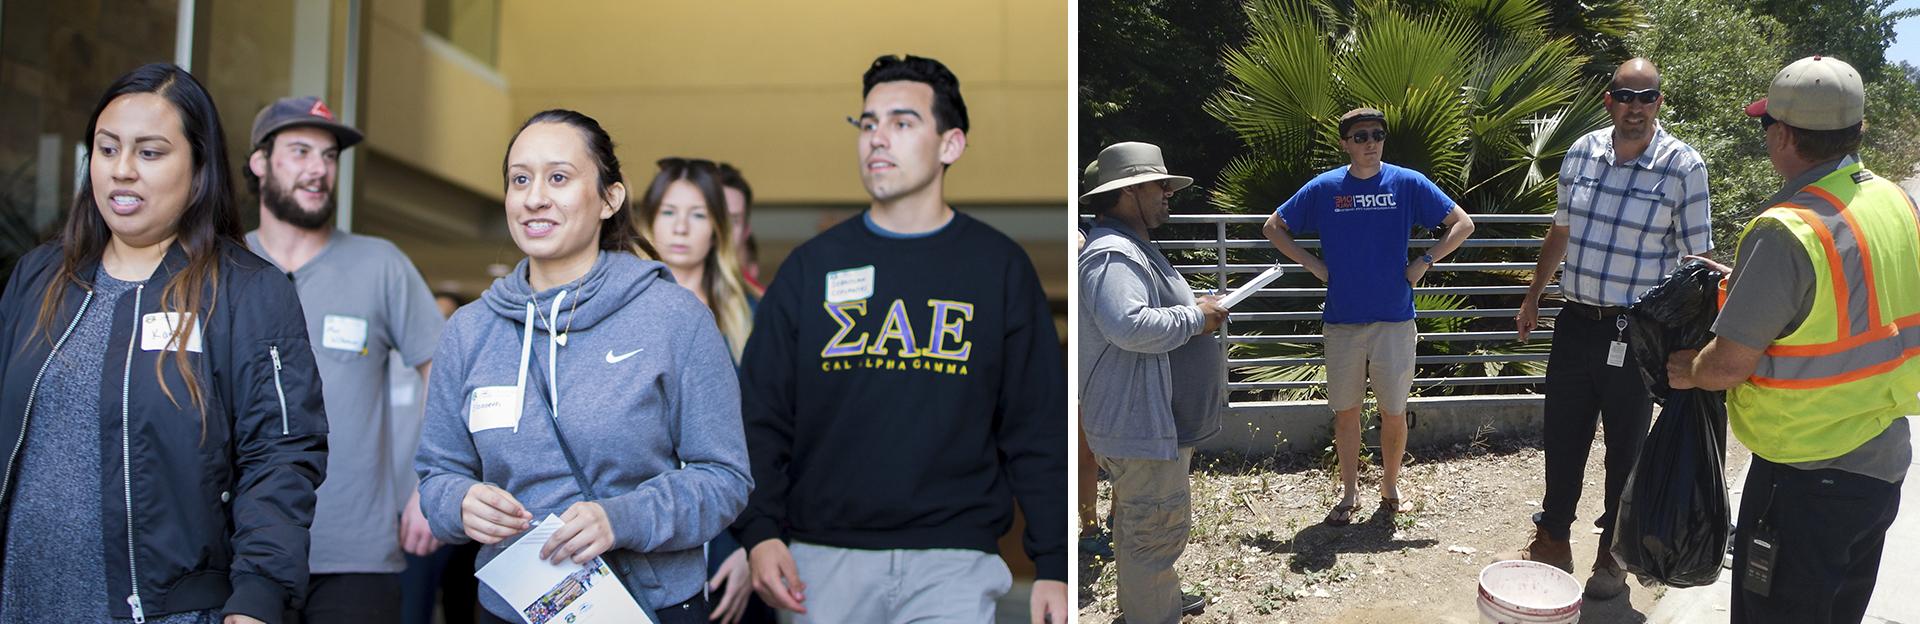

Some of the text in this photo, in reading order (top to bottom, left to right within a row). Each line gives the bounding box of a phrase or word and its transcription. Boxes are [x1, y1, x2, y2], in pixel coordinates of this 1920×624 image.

[822, 358, 969, 375] CAL LPHA GAMMA
